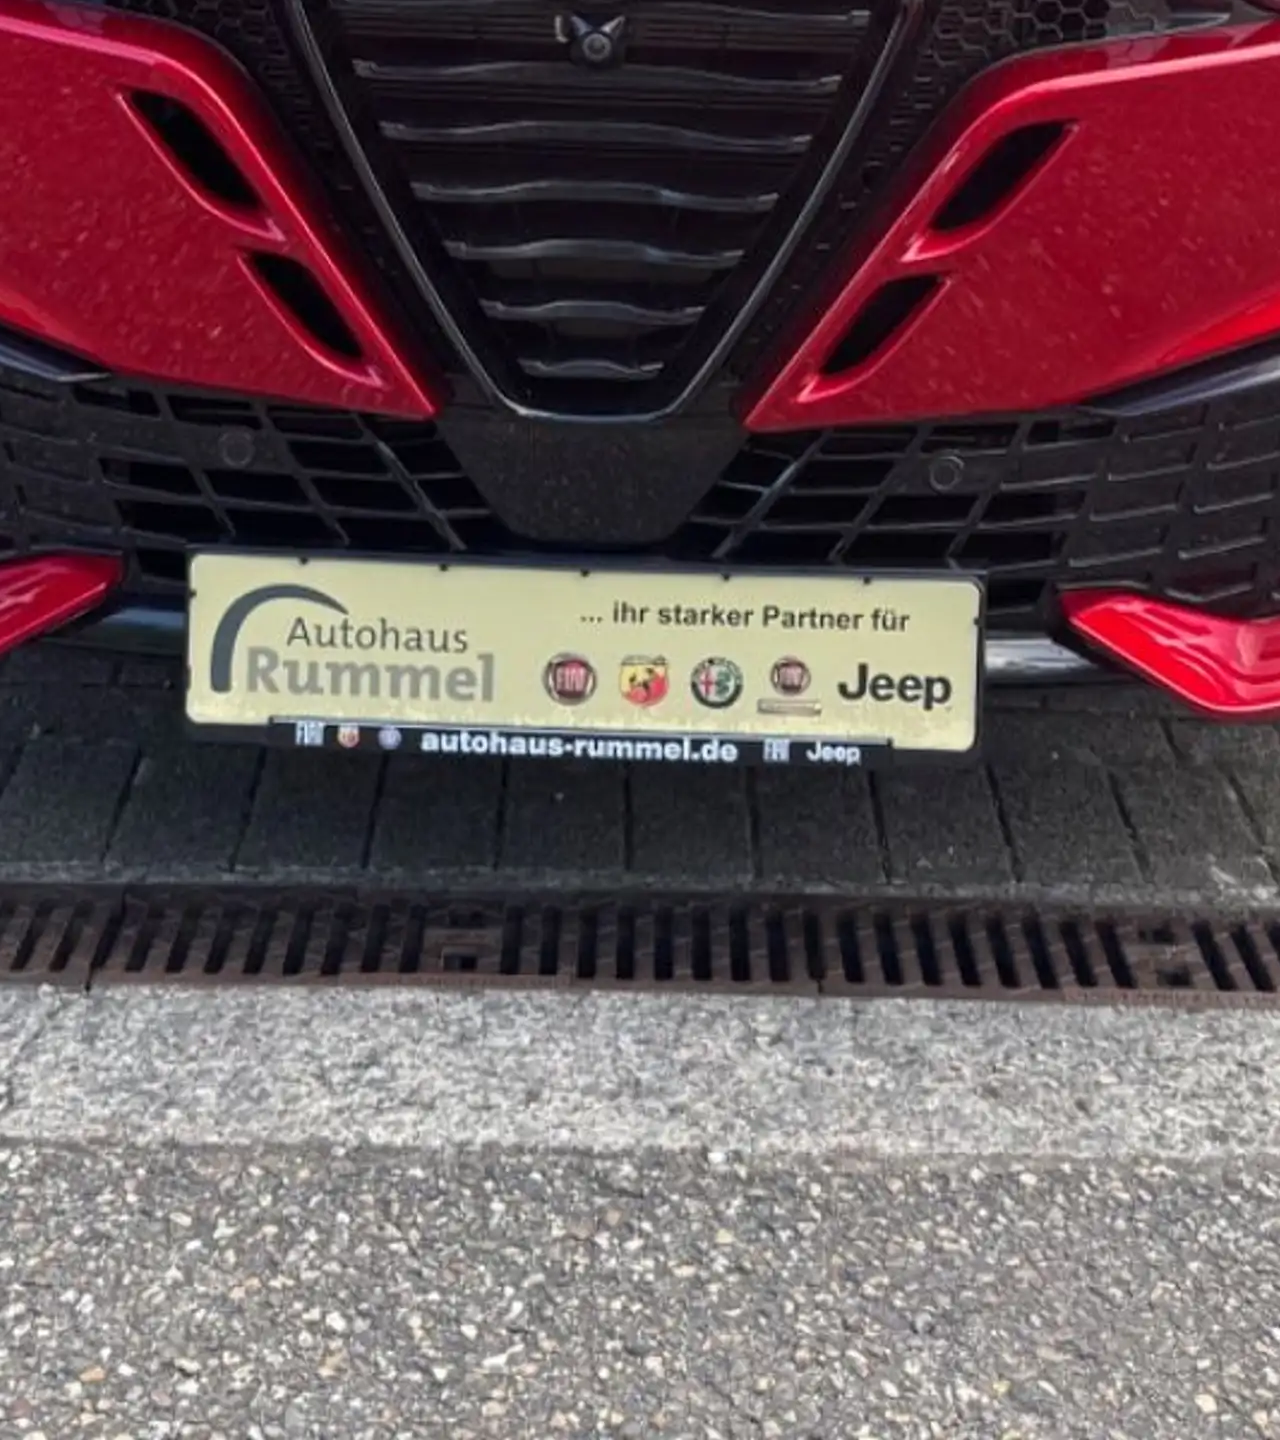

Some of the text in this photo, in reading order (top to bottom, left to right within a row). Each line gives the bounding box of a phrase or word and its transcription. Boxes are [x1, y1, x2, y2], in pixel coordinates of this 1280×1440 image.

[613, 601, 650, 624] ihr
[658, 603, 754, 627] starker
[762, 605, 864, 630] Partner
[871, 608, 910, 631] für
[287, 616, 468, 653] Autohaus
[246, 646, 495, 702] Rummel
[838, 663, 952, 708] Jeep
[422, 730, 738, 762] autohaus-rummel.de
[806, 741, 861, 765] Jeep
